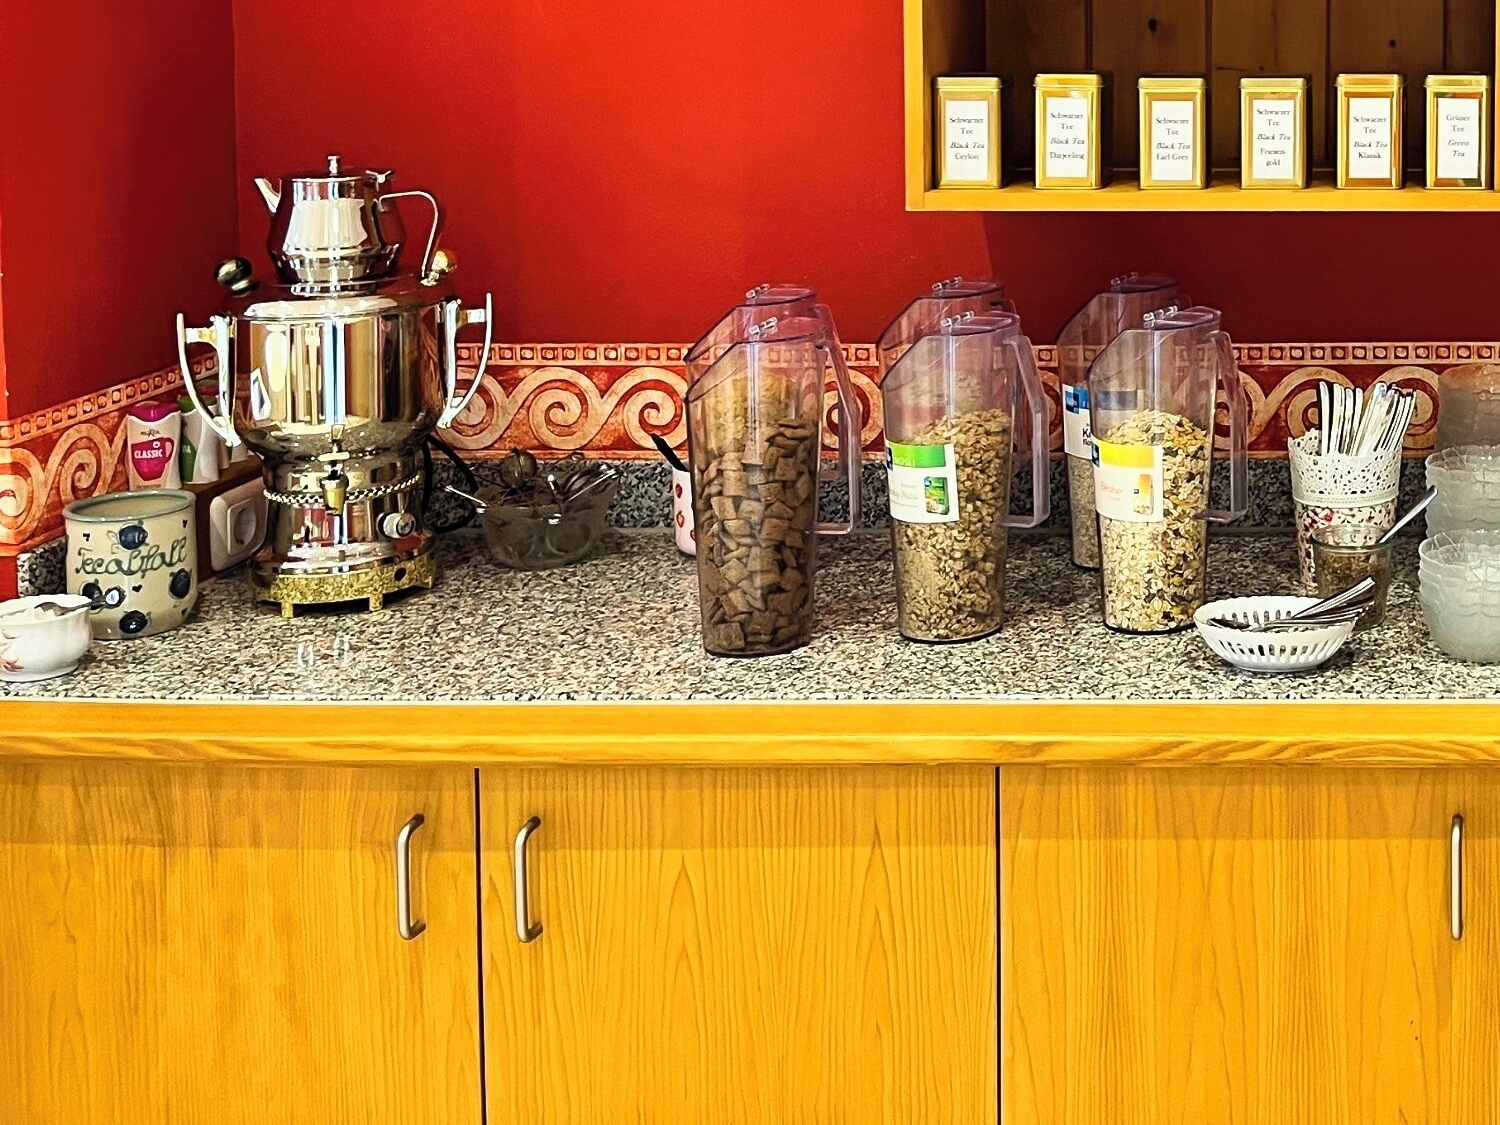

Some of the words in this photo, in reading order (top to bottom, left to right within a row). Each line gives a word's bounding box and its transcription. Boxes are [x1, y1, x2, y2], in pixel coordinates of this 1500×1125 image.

[954, 153, 979, 161] Ceylon
[1049, 152, 1084, 160] Darjeeling
[1171, 153, 1188, 161] Grey
[134, 449, 163, 459] CLASSIC
